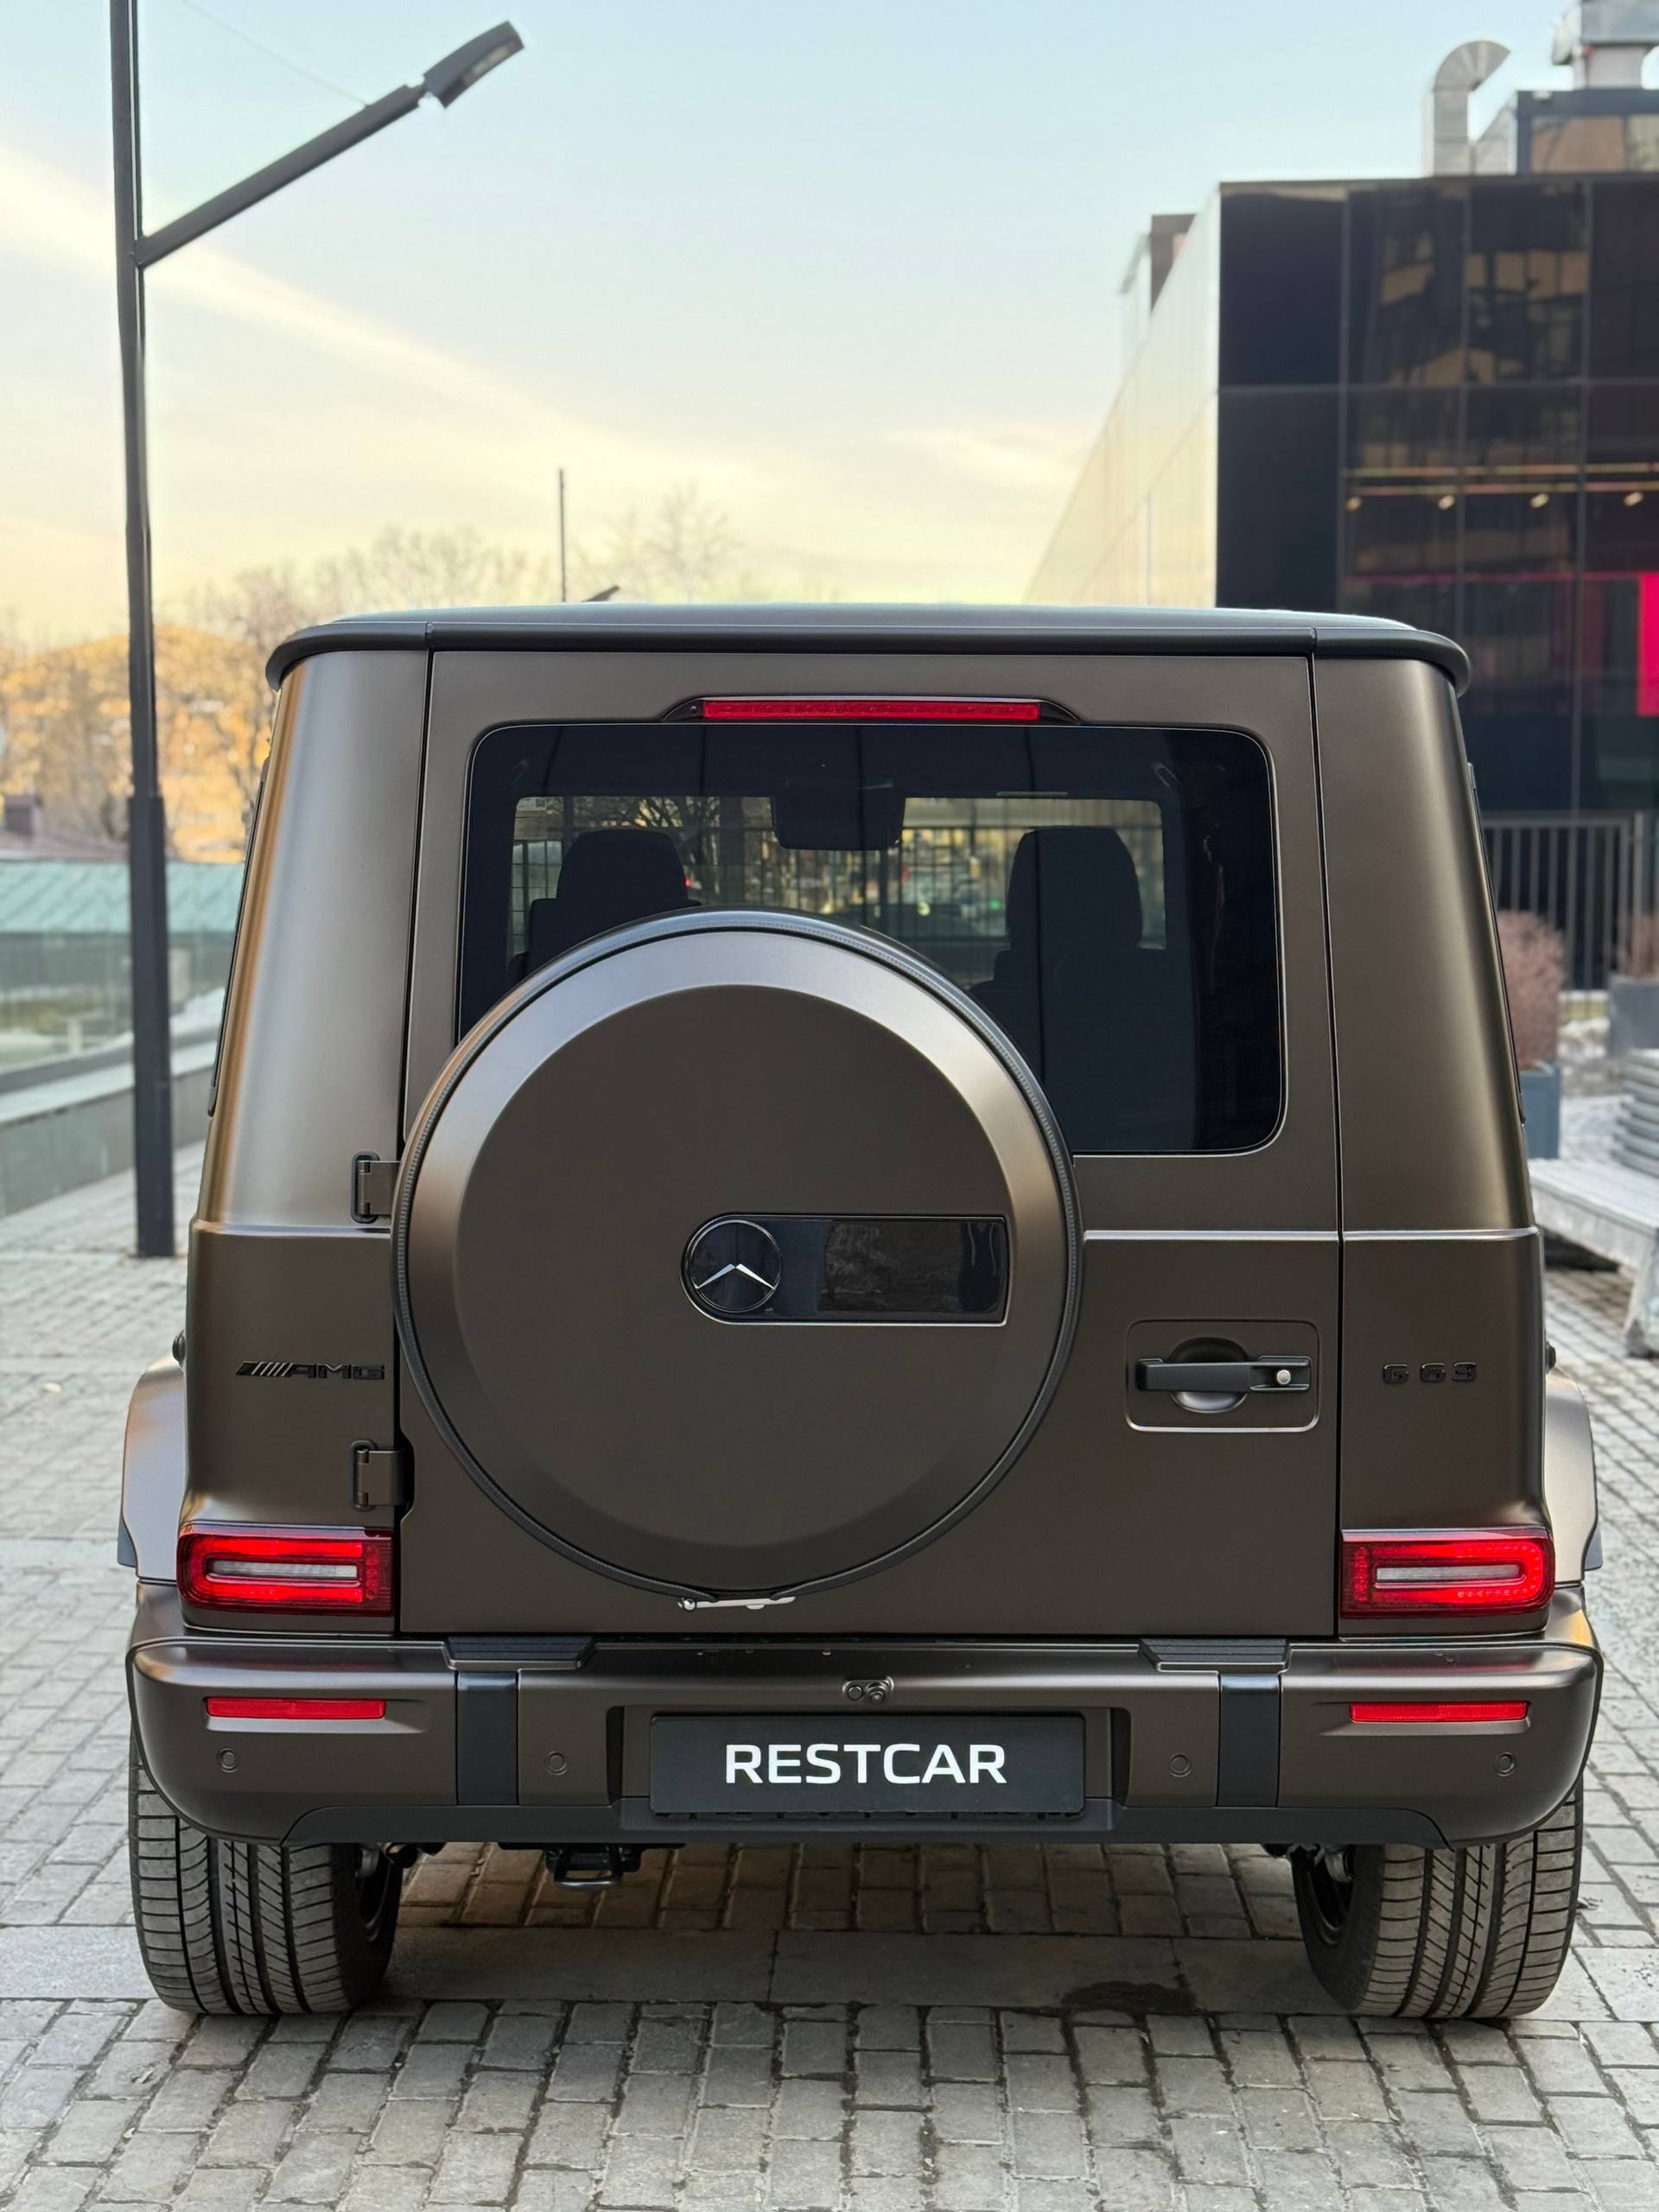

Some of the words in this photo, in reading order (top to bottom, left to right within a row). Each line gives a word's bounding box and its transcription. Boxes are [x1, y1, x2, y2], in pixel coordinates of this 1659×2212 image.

[286, 1362, 385, 1380] AMG
[1382, 1363, 1409, 1383] G
[725, 1744, 1007, 1784] RESTCAR
